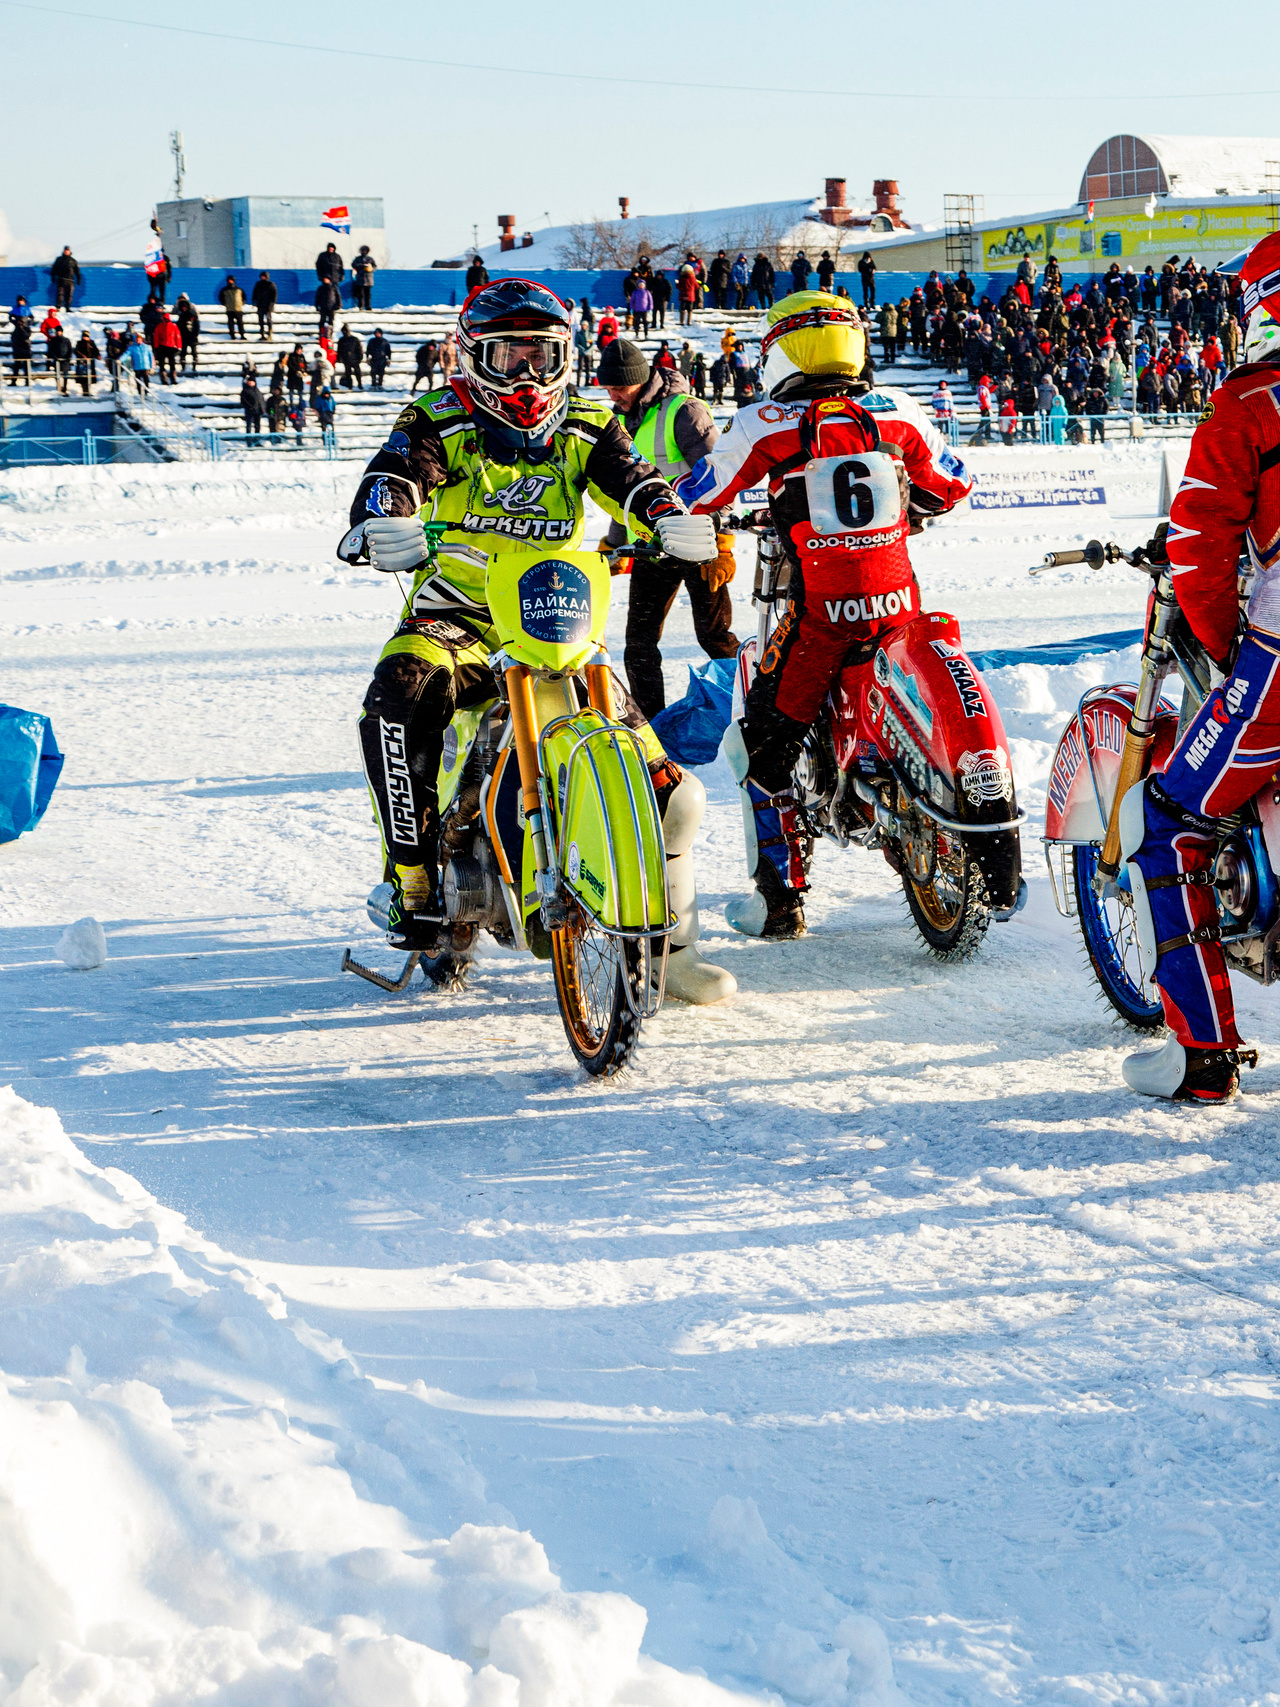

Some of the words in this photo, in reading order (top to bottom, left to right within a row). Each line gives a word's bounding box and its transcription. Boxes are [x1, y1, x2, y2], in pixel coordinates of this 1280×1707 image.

[832, 460, 876, 529] 6
[462, 512, 575, 540] ИРКУТСК
[522, 562, 587, 585] СТРОИТЕЛЬСТВО
[522, 593, 590, 611] БАЙКАЛ
[524, 609, 589, 621] СУДОРЕМОНТ
[825, 586, 913, 623] VOLKOV
[526, 624, 561, 640] РЕМОНТ
[945, 659, 988, 718] SHAAZ
[1184, 717, 1224, 771] MEGA
[380, 716, 419, 846] ИРКУТСК
[1049, 730, 1083, 817] MEGA
[1093, 709, 1126, 758] LAD
